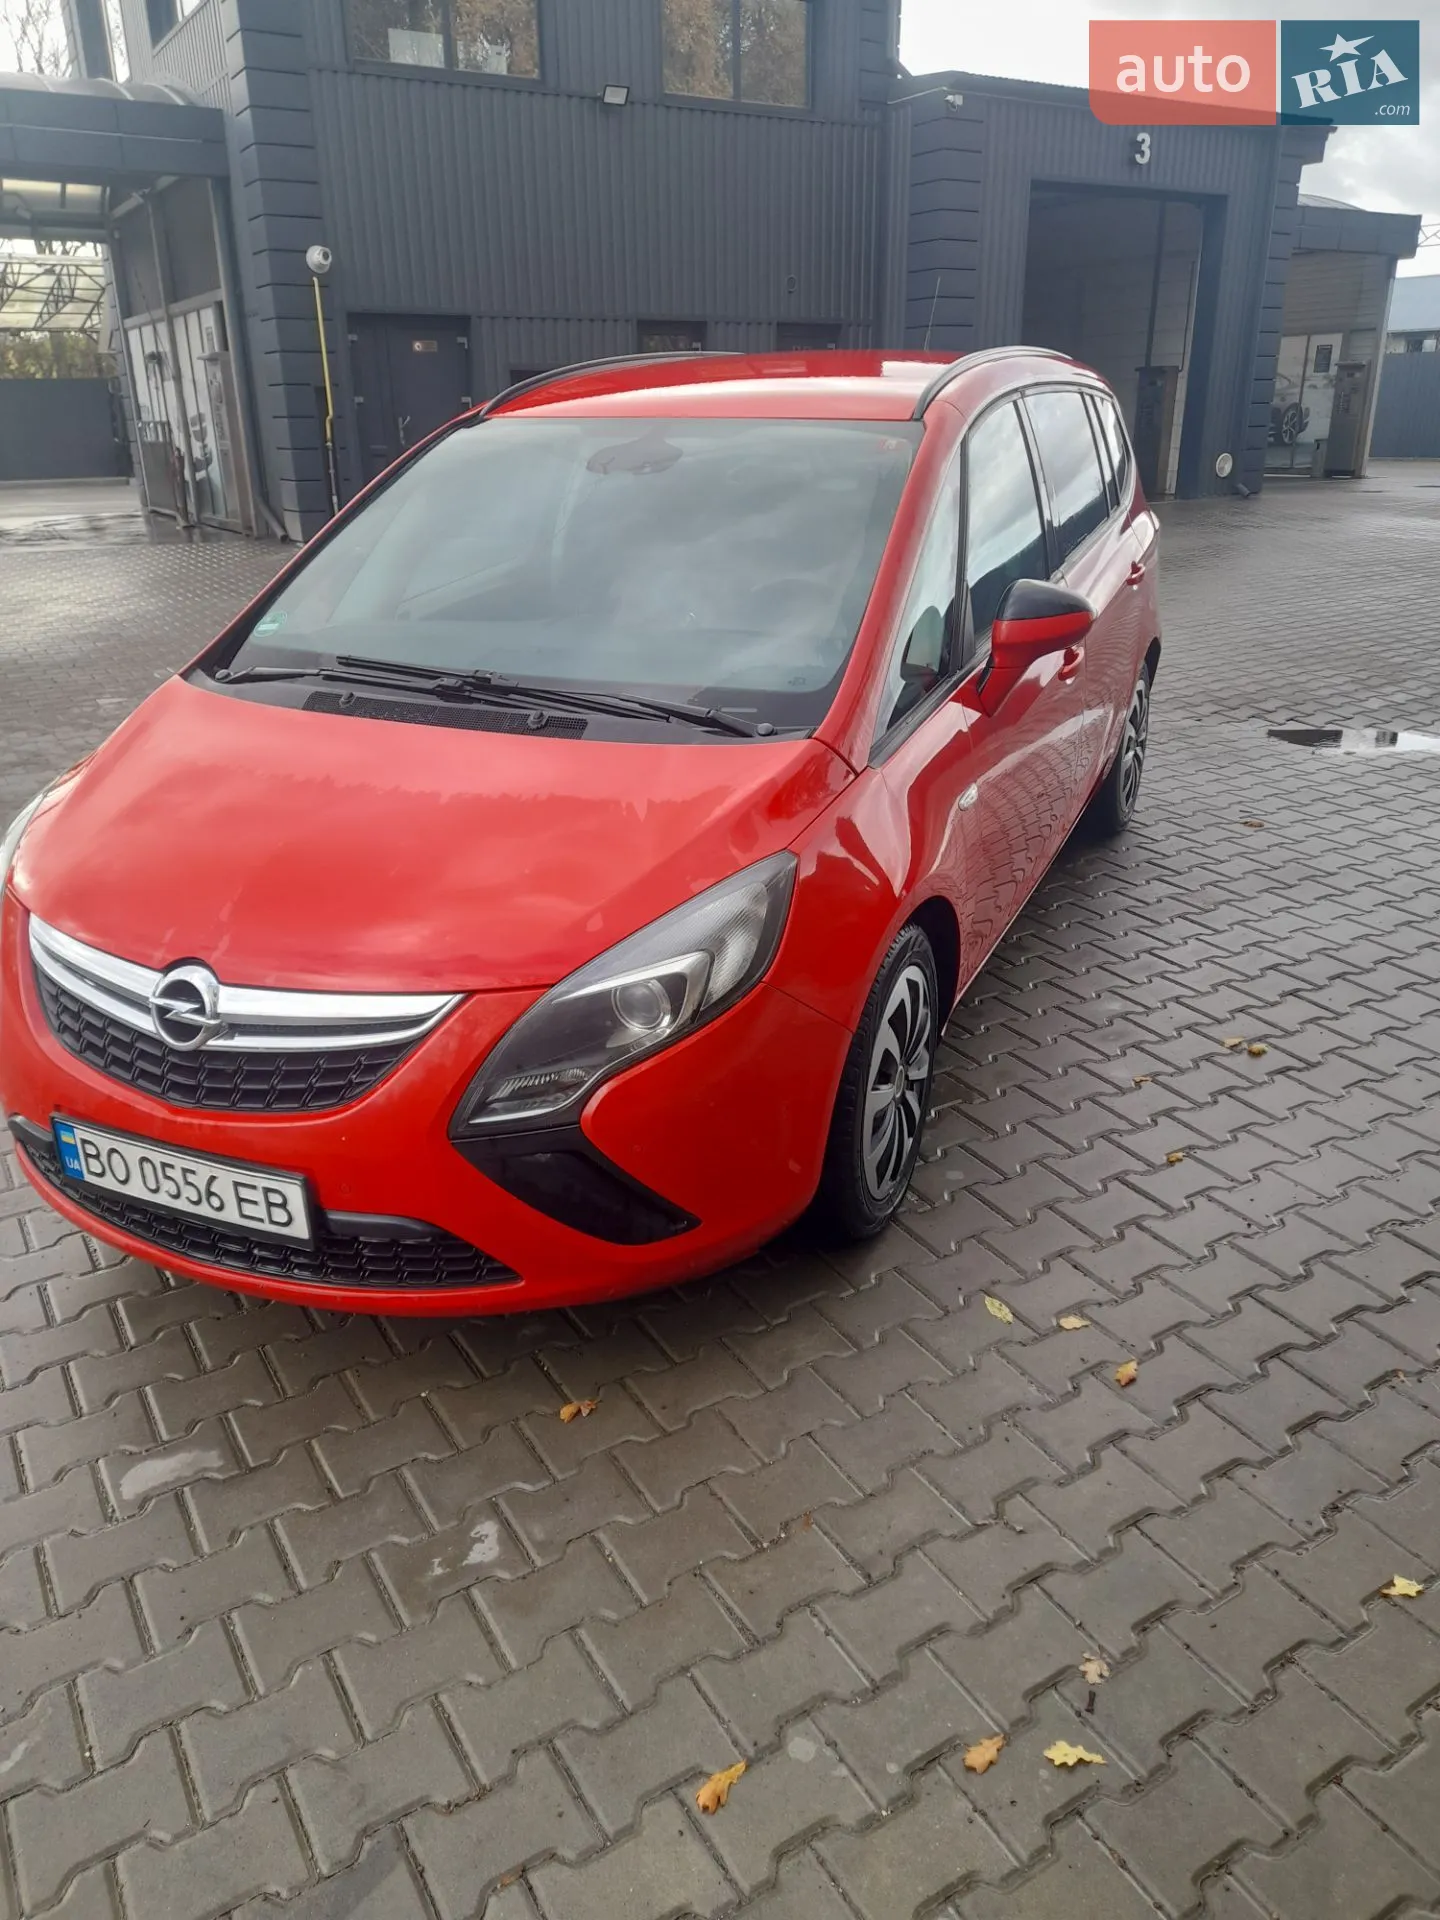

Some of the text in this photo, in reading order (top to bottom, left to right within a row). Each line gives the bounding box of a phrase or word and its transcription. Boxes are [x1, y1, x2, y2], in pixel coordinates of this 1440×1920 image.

[1135, 132, 1151, 165] 3
[66, 1158, 80, 1171] UA
[80, 1138, 293, 1228] BO 0556 EB
